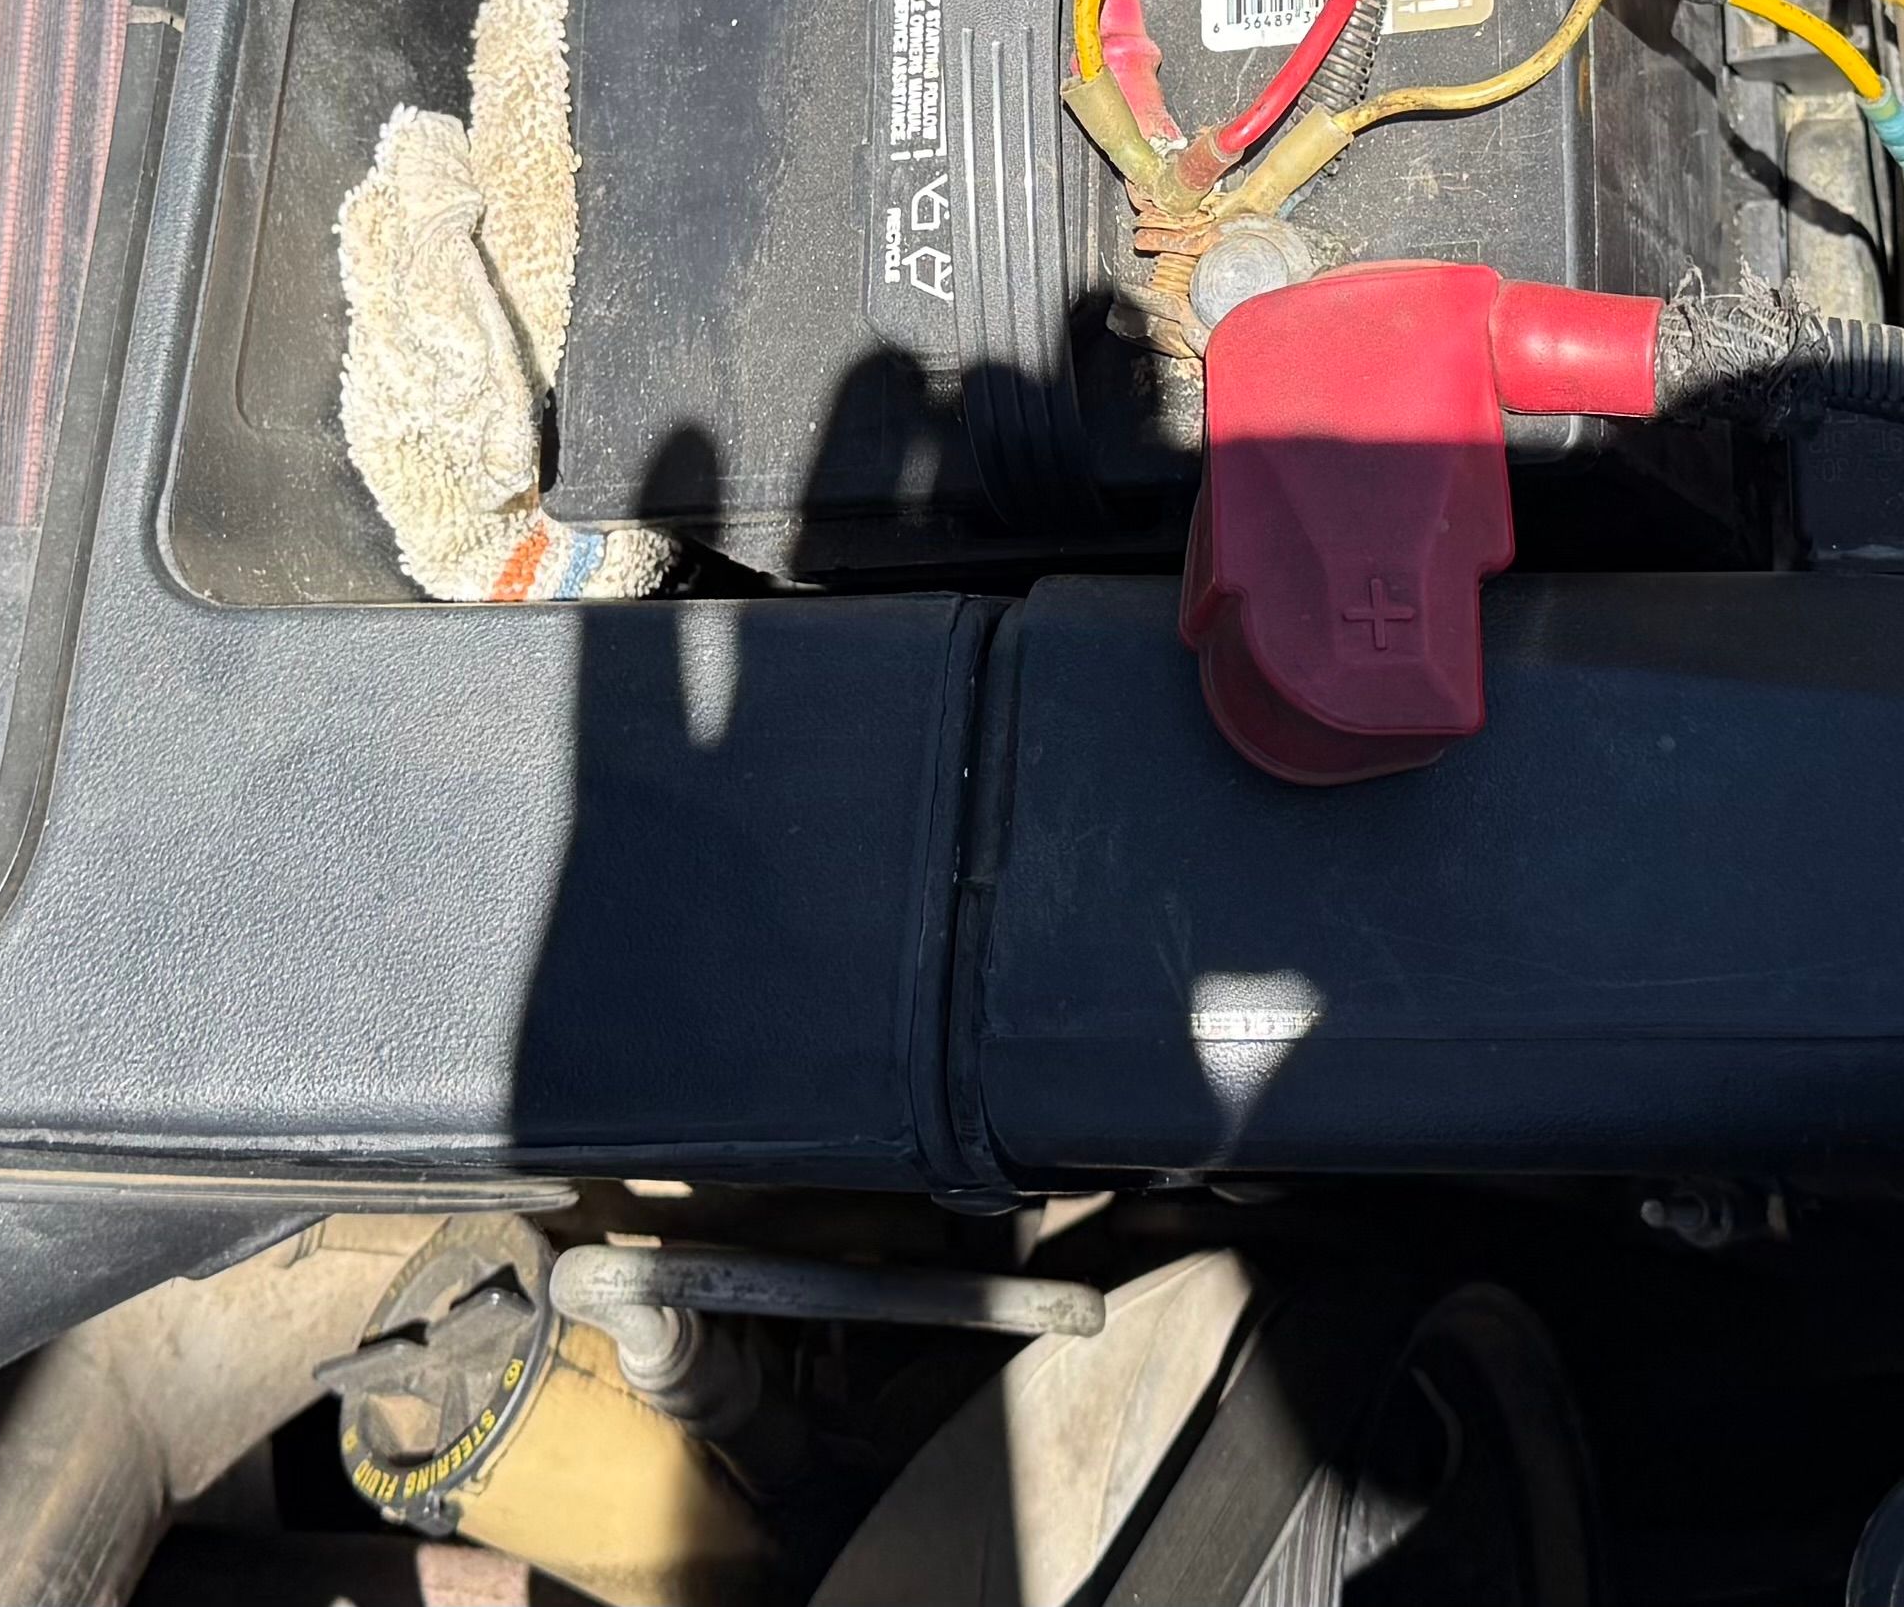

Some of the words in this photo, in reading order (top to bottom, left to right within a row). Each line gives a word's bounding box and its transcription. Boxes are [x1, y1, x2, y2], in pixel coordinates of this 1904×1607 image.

[884, 207, 901, 284] RECYCLE
[352, 1458, 400, 1504] FLUID
[403, 1408, 496, 1499] STEERING
